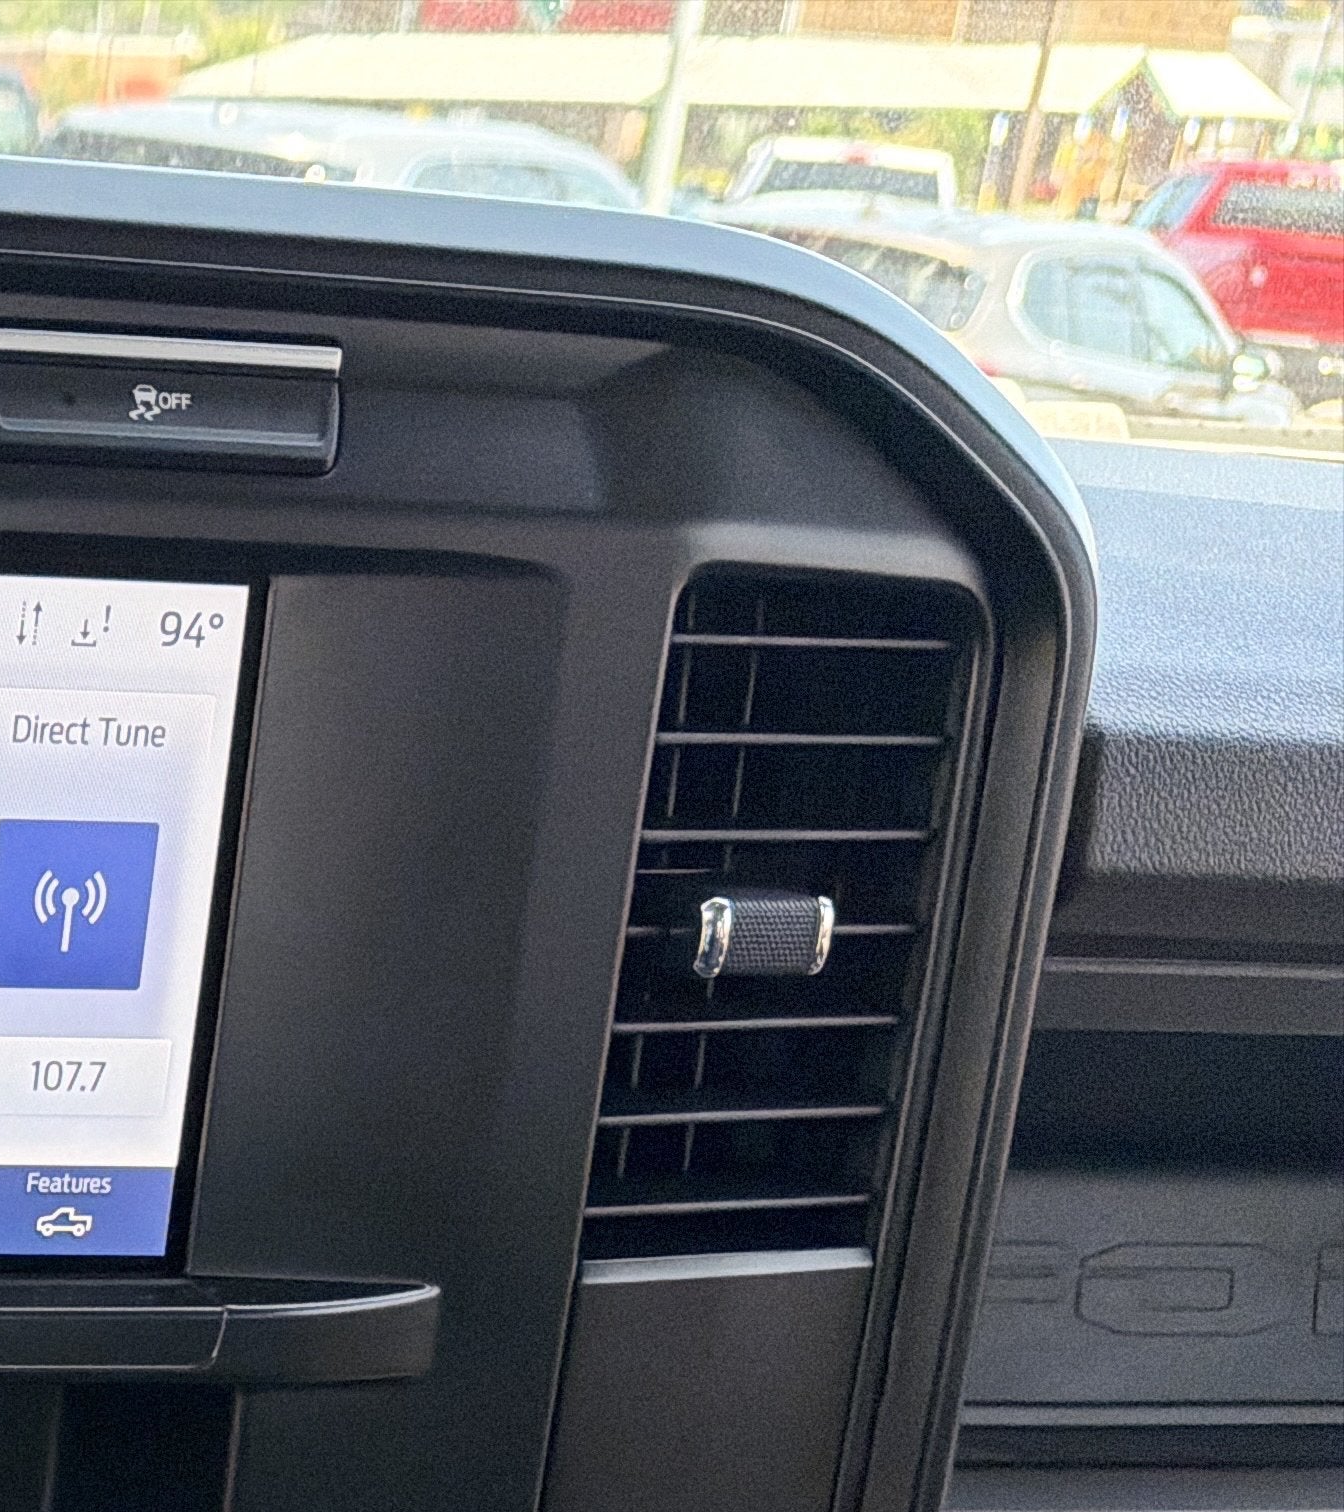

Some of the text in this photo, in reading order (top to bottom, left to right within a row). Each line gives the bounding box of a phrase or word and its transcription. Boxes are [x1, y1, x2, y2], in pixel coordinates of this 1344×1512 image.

[158, 392, 191, 410] OFF
[160, 611, 224, 649] 94°
[12, 714, 166, 747] Direct Tune
[31, 1060, 107, 1092] 107.7
[26, 1172, 112, 1194] Features
